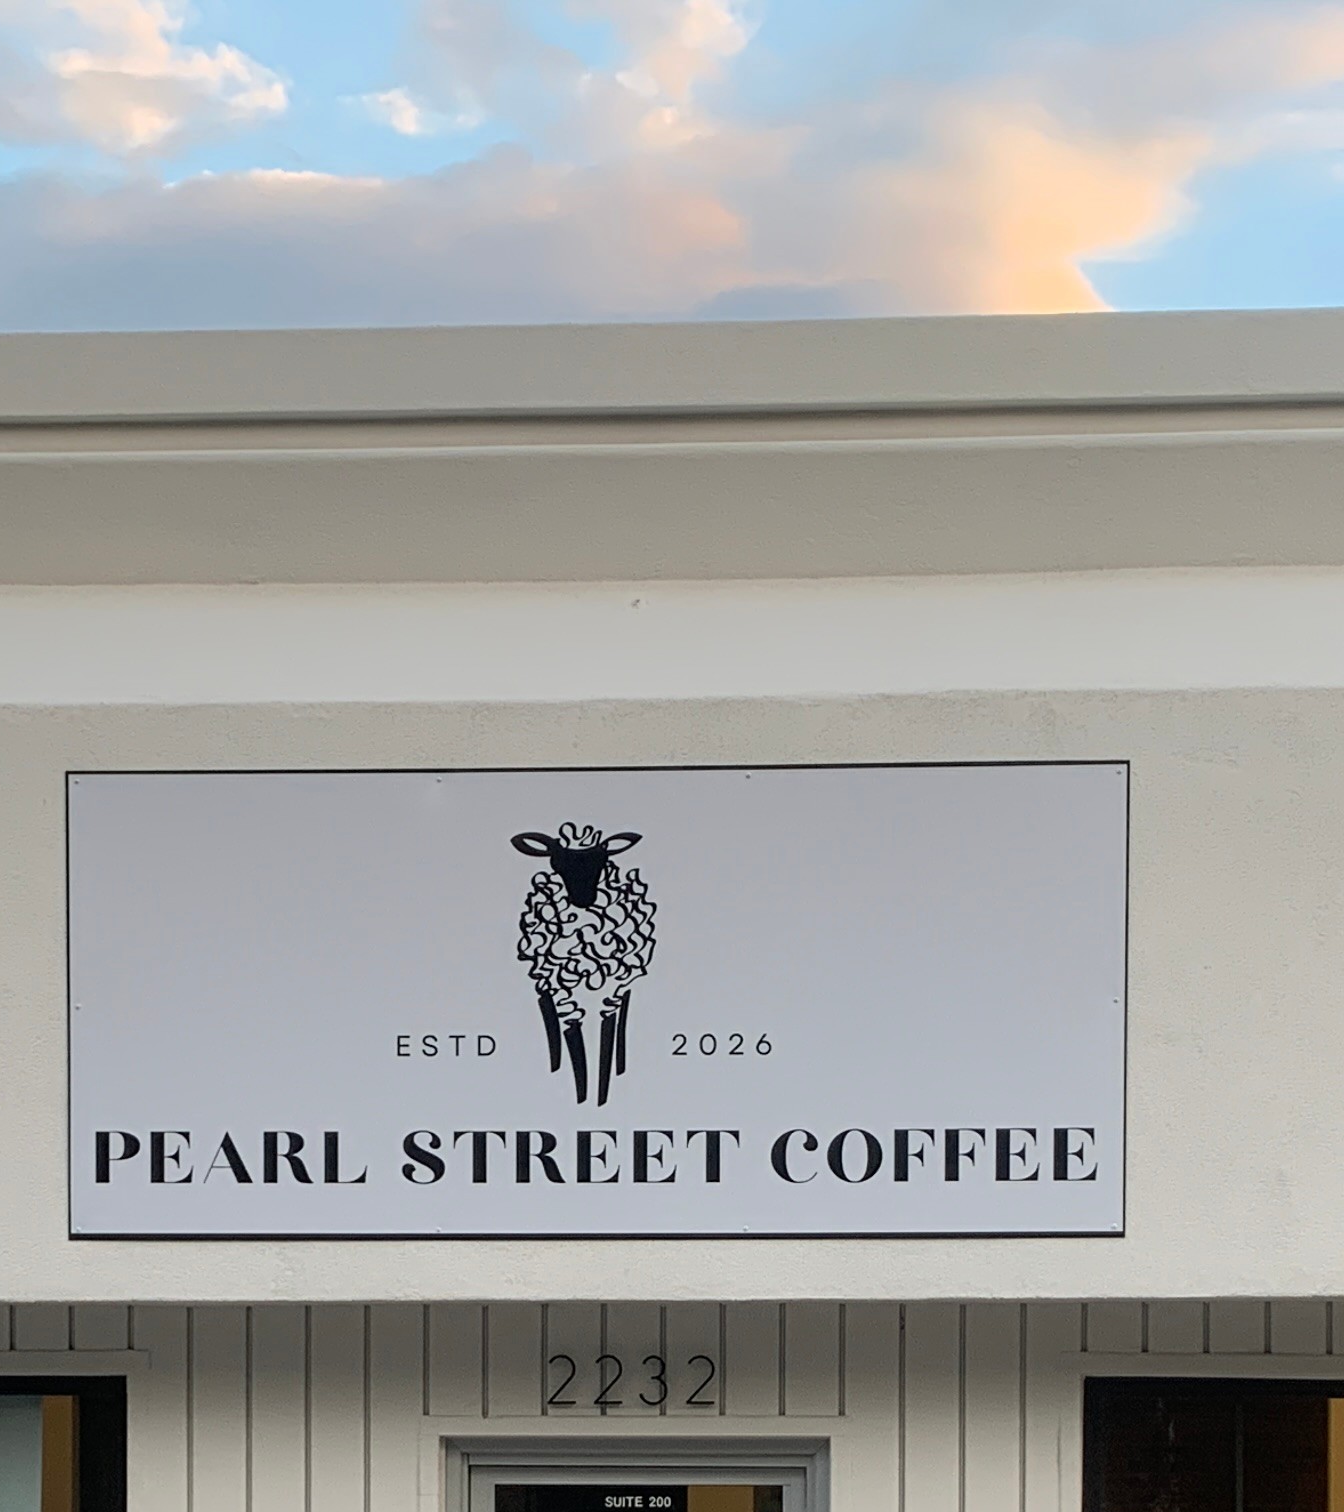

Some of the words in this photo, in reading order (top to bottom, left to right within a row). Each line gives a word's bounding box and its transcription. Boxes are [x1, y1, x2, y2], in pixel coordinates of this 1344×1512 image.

[396, 1034, 496, 1057] ESTD
[672, 1033, 772, 1056] 2026
[94, 1130, 368, 1185] PEARL
[401, 1129, 740, 1185] STREET
[770, 1127, 1098, 1184] COFFEE
[547, 1355, 716, 1406] 2232
[604, 1495, 644, 1508] SUITE
[648, 1496, 672, 1508] 200
